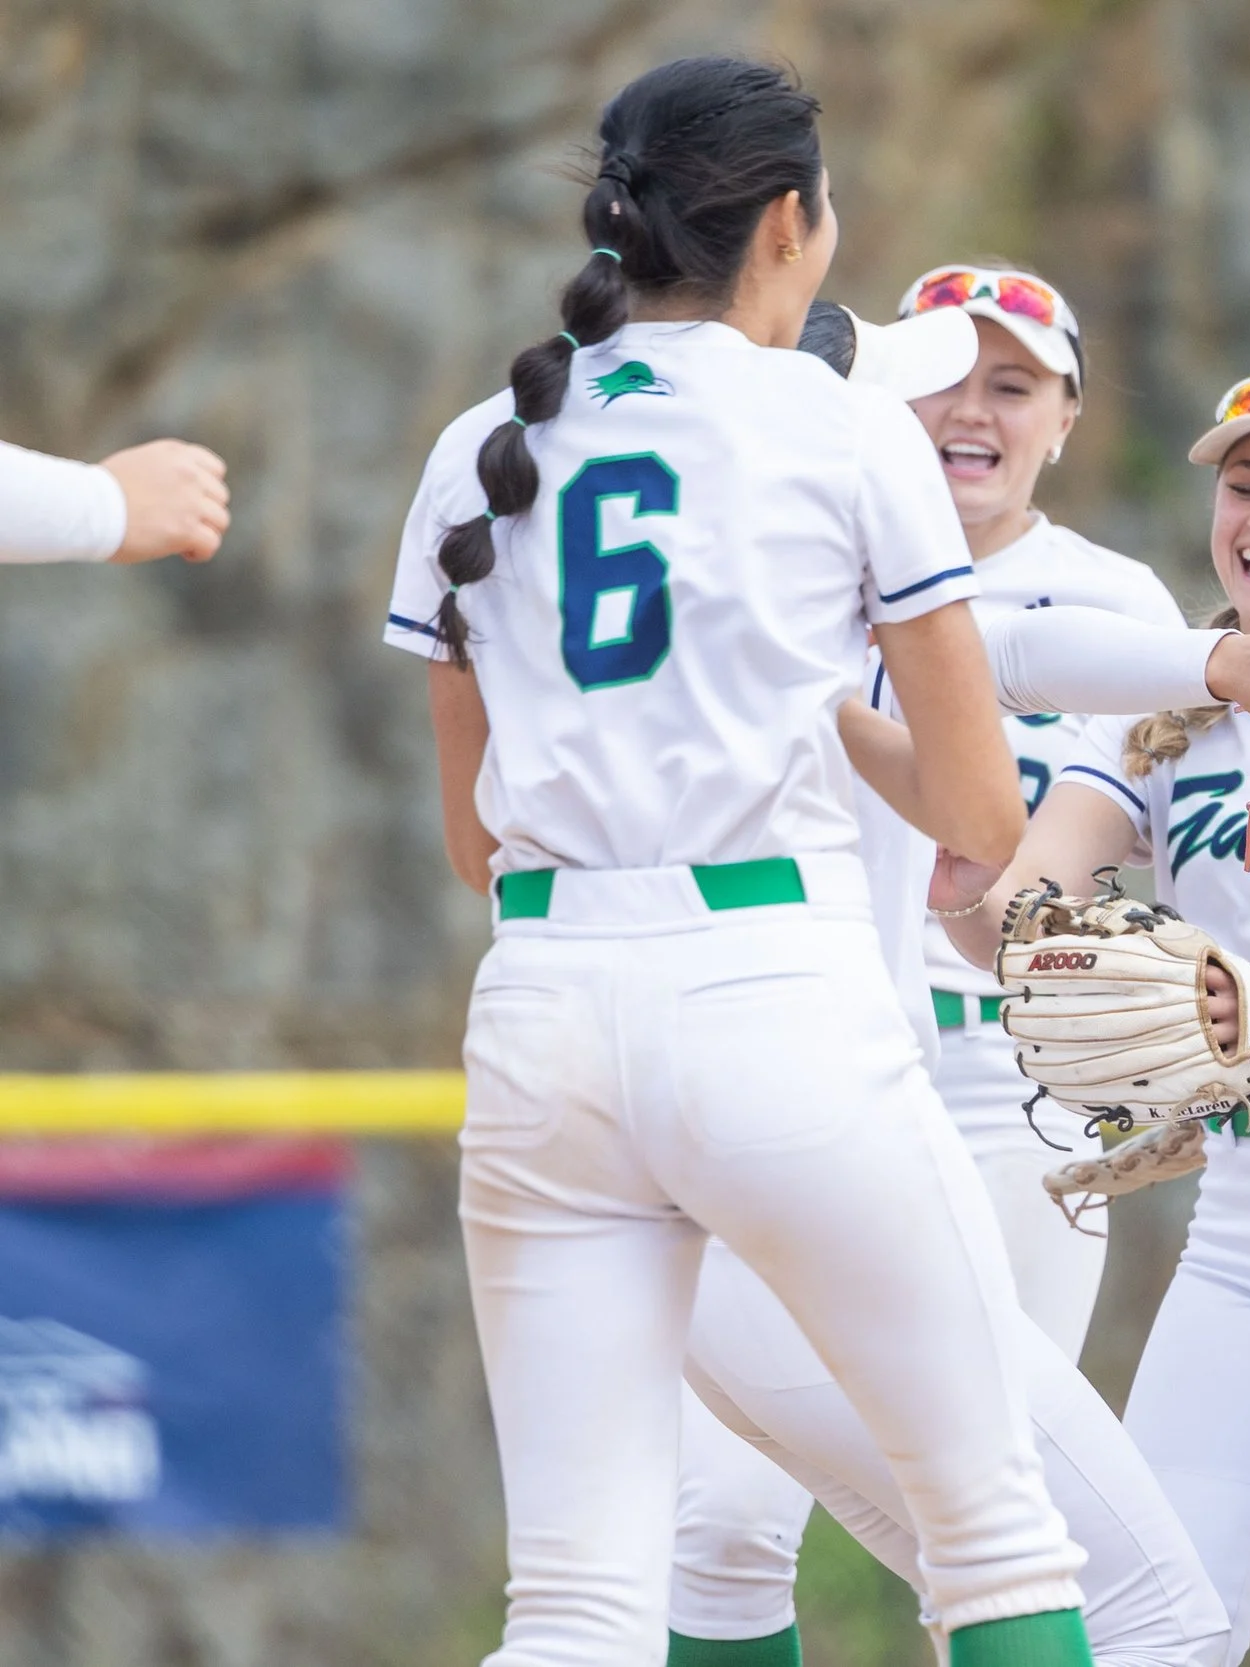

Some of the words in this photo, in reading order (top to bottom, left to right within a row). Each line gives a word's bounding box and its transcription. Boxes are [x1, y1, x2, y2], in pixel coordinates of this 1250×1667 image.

[557, 451, 681, 694] 6
[1027, 952, 1098, 972] A2000
[1148, 1107, 1165, 1119] K.
[1168, 1099, 1232, 1117] cLaren
